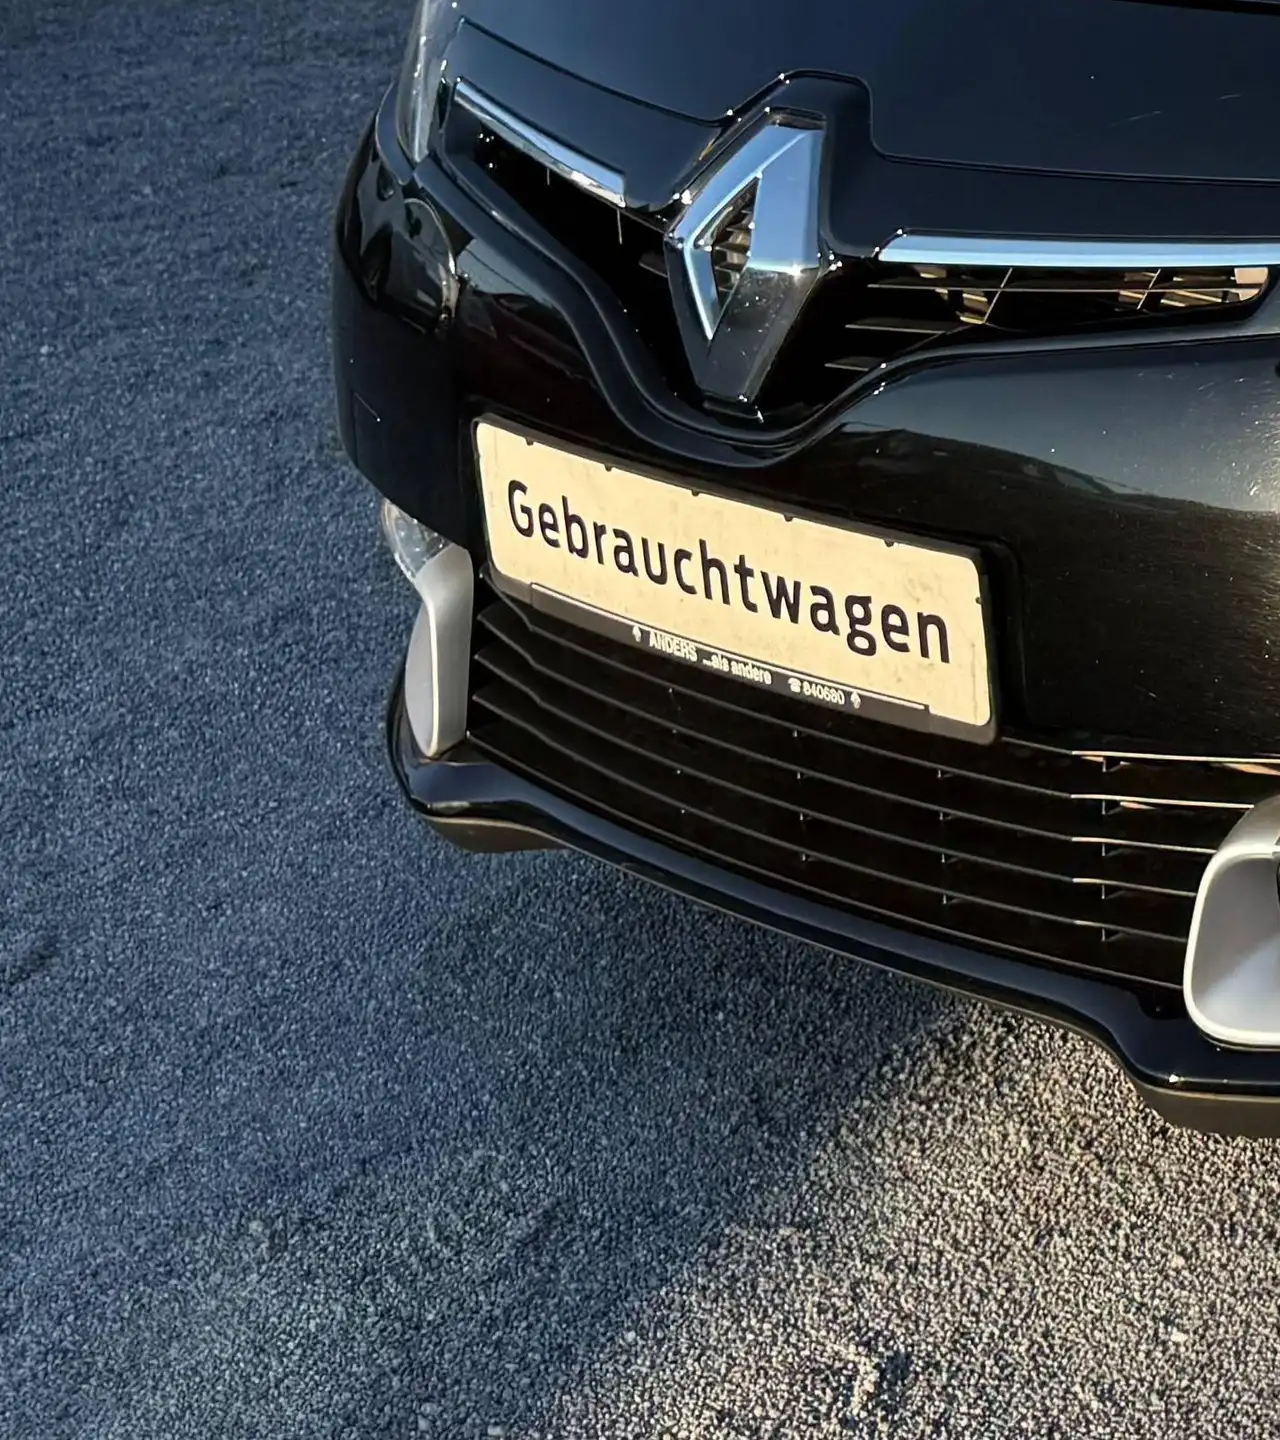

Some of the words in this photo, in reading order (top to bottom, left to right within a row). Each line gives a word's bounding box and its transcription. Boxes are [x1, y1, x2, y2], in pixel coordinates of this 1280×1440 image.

[507, 478, 951, 664] Gebrauchtwagen
[649, 630, 698, 662] ANDERS
[731, 659, 772, 685] andere
